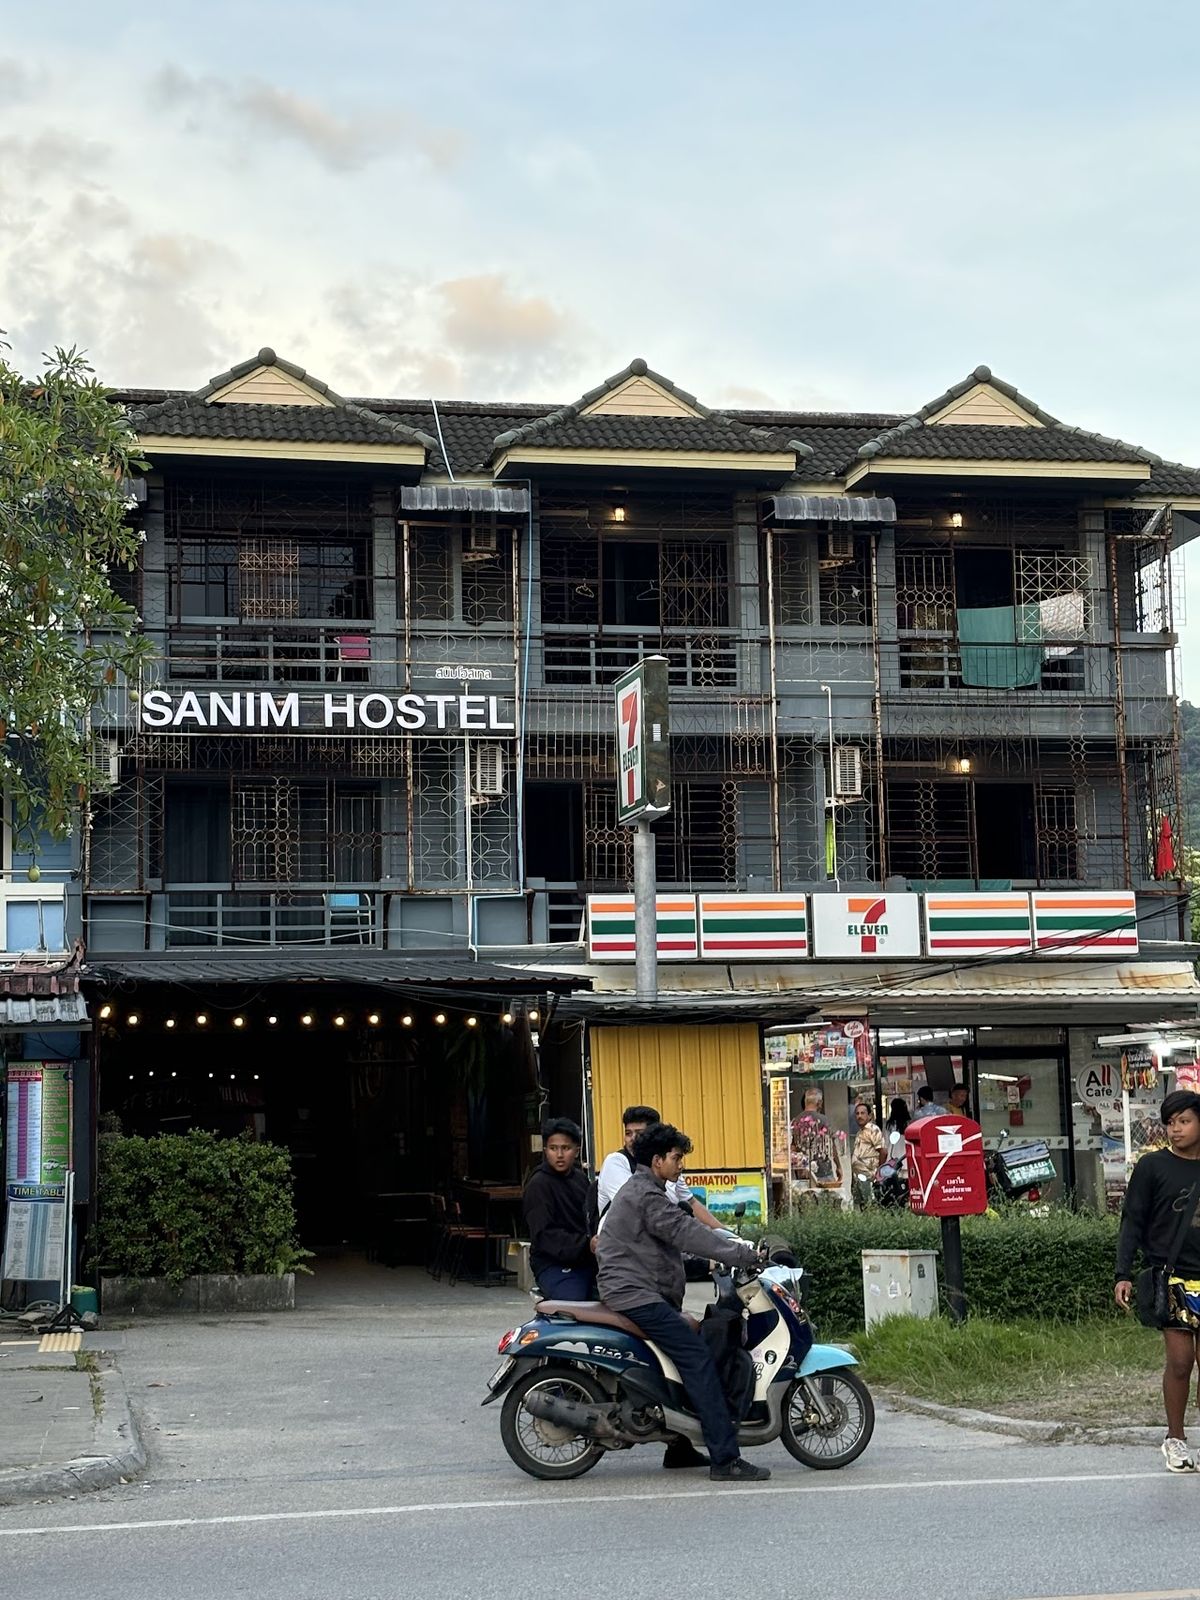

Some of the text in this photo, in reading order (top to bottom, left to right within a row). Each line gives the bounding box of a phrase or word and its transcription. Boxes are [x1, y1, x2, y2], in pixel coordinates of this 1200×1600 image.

[142, 690, 515, 730] SANIM HOSTEL
[622, 690, 638, 808] 7
[847, 898, 886, 953] 7
[1086, 1064, 1111, 1087] All
[13, 1187, 36, 1196] TIME
[684, 1174, 738, 1186] ORMATION
